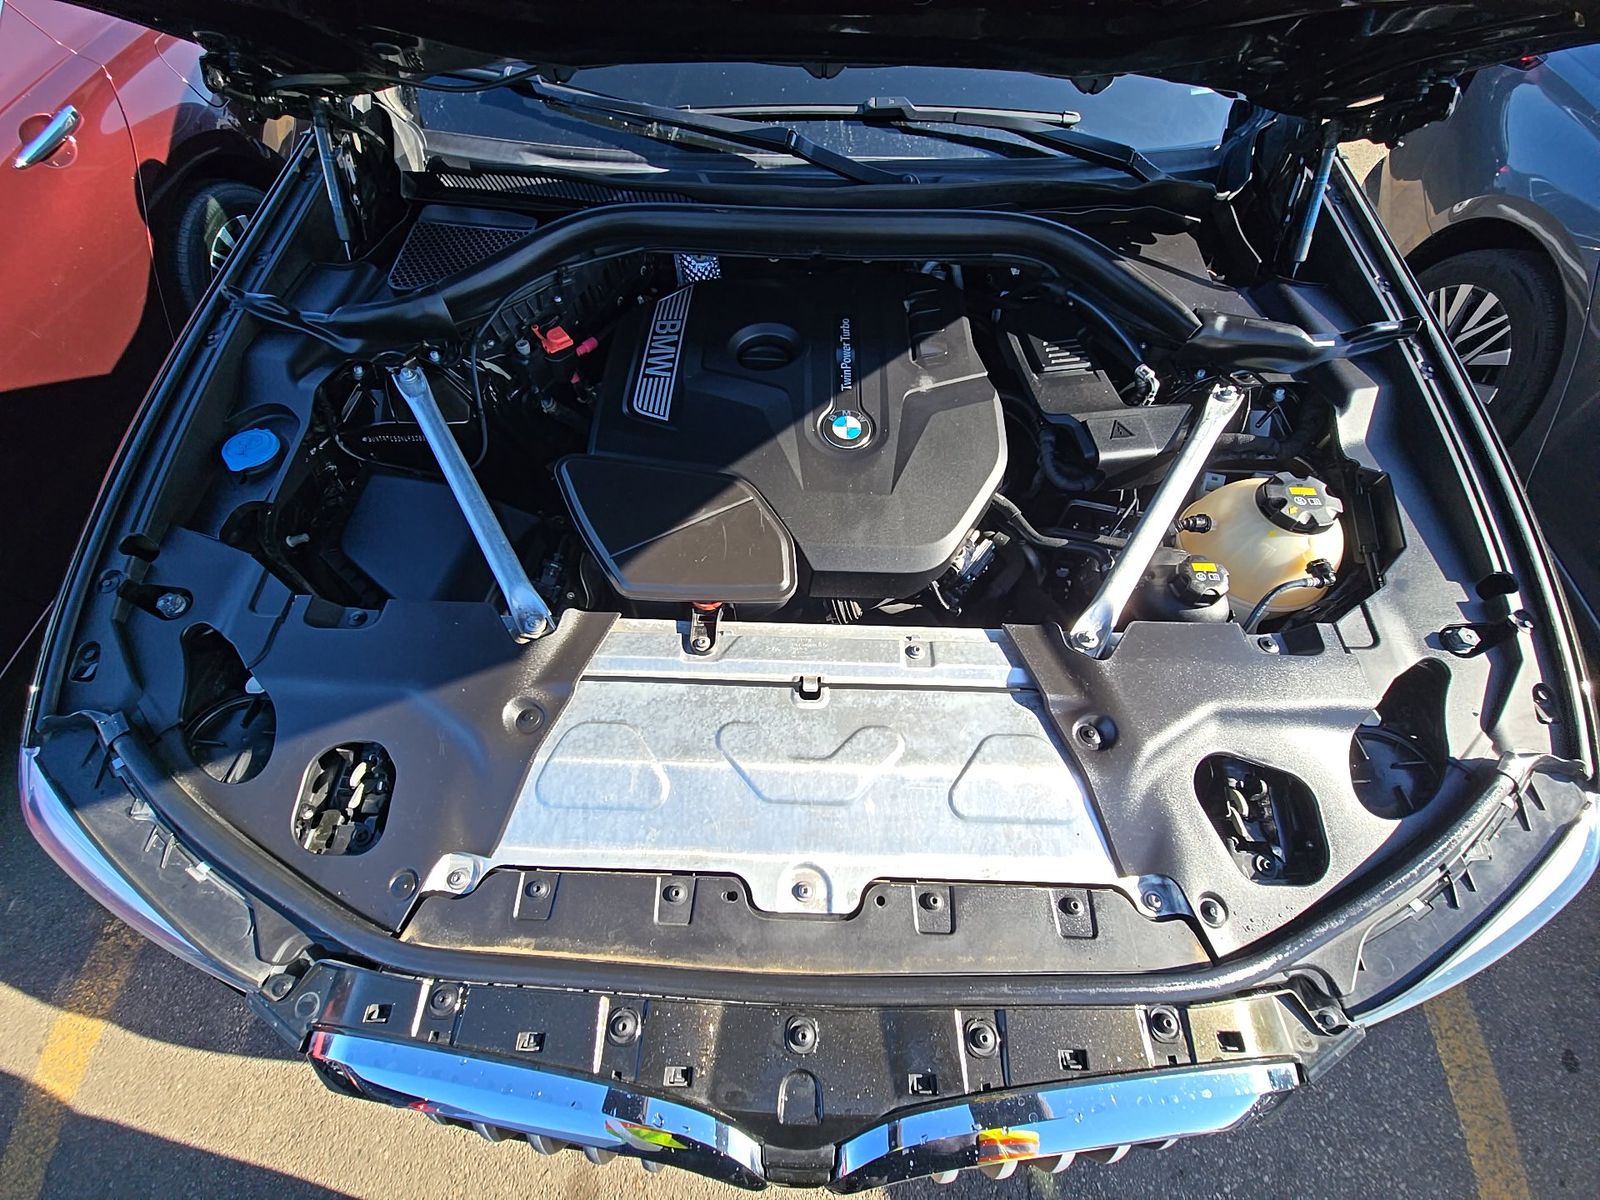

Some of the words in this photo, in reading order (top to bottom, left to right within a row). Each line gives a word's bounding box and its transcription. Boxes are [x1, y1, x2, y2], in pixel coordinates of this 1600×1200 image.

[643, 319, 682, 377] BMW
[839, 318, 850, 342] Turbo
[840, 343, 852, 391] TwinPower
[828, 409, 867, 423] BMW
